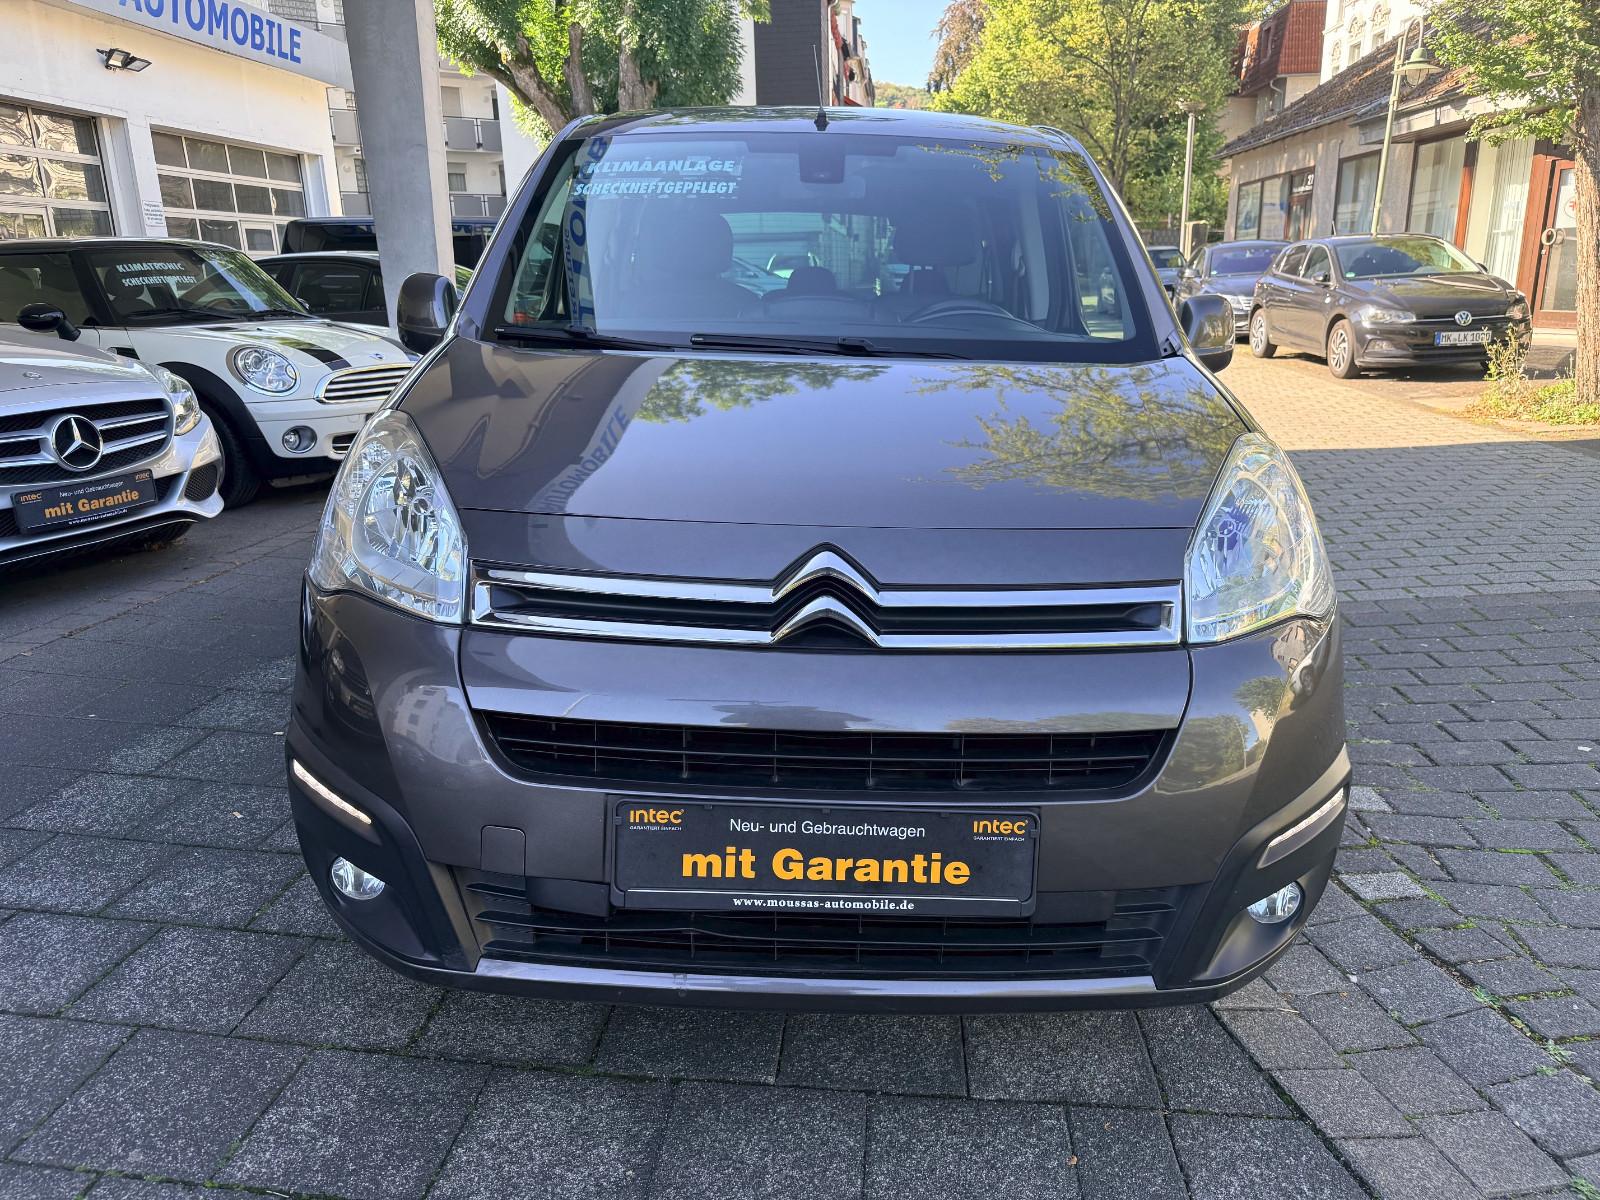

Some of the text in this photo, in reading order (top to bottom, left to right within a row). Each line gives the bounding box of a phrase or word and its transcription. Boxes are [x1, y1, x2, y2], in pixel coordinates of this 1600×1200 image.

[587, 160, 735, 174] KLIMAANLAGE
[574, 182, 737, 196] SCHECKHEFTGEPFLEGT
[116, 262, 184, 272] KLIMATRONIC
[44, 489, 140, 519] mit Garantie
[629, 808, 682, 824] intec
[730, 818, 926, 840] Neu- und Gebrauchtwagen
[973, 819, 1025, 835] intec
[682, 845, 971, 885] mit Garantie
[733, 897, 915, 910] www.moussas-automobile.de
